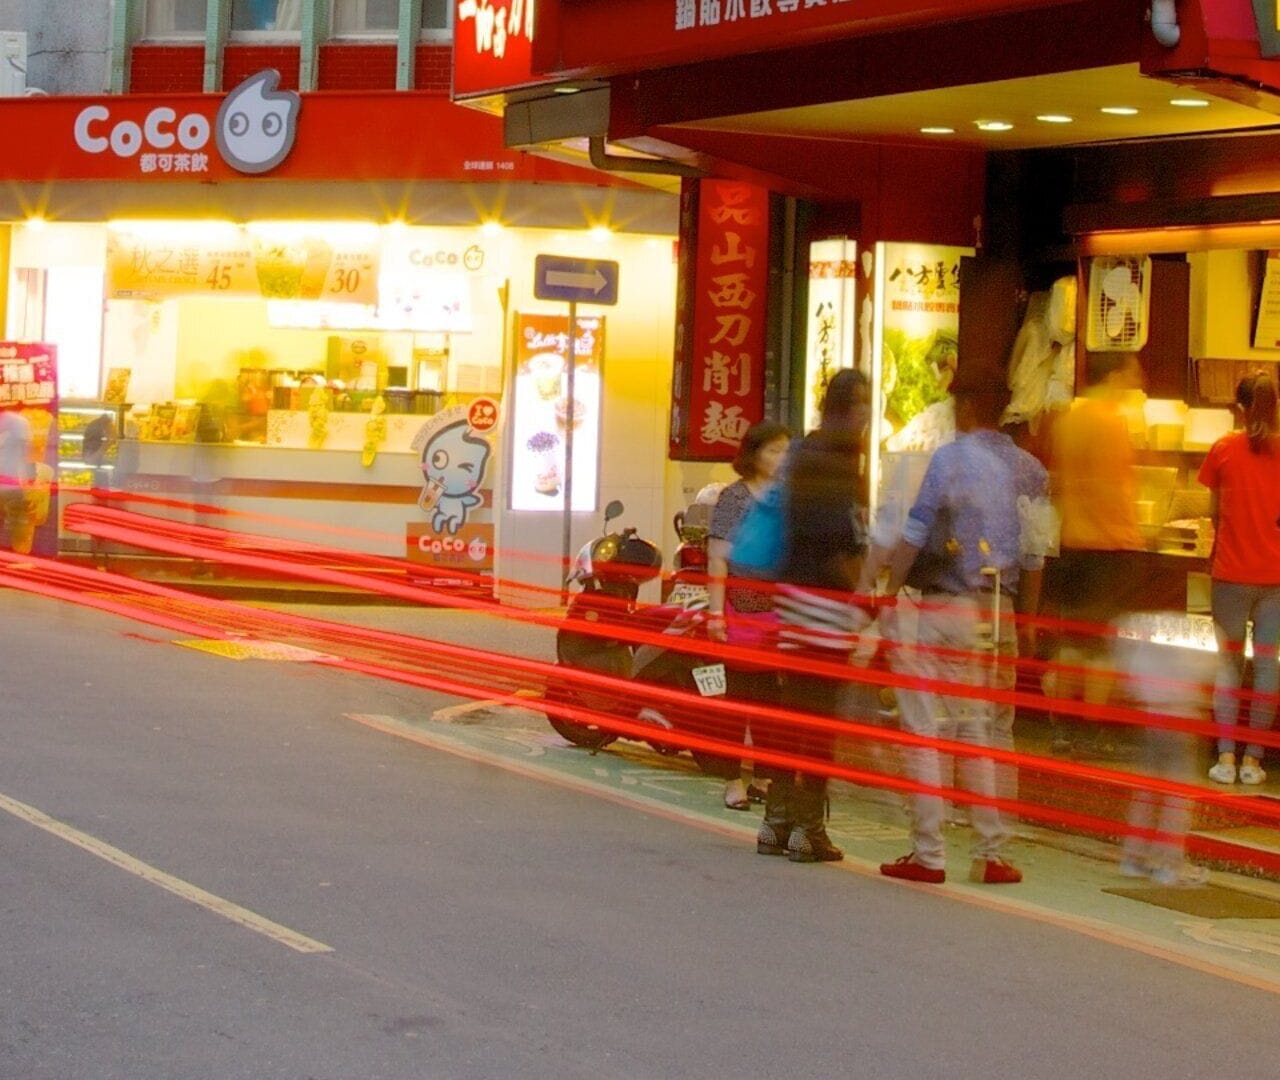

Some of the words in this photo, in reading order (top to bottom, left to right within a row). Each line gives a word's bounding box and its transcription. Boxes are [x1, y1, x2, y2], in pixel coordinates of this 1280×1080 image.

[74, 105, 210, 157] CoCo
[139, 153, 208, 173] 都可茶飲
[206, 265, 232, 291] 45
[330, 268, 360, 293] 30
